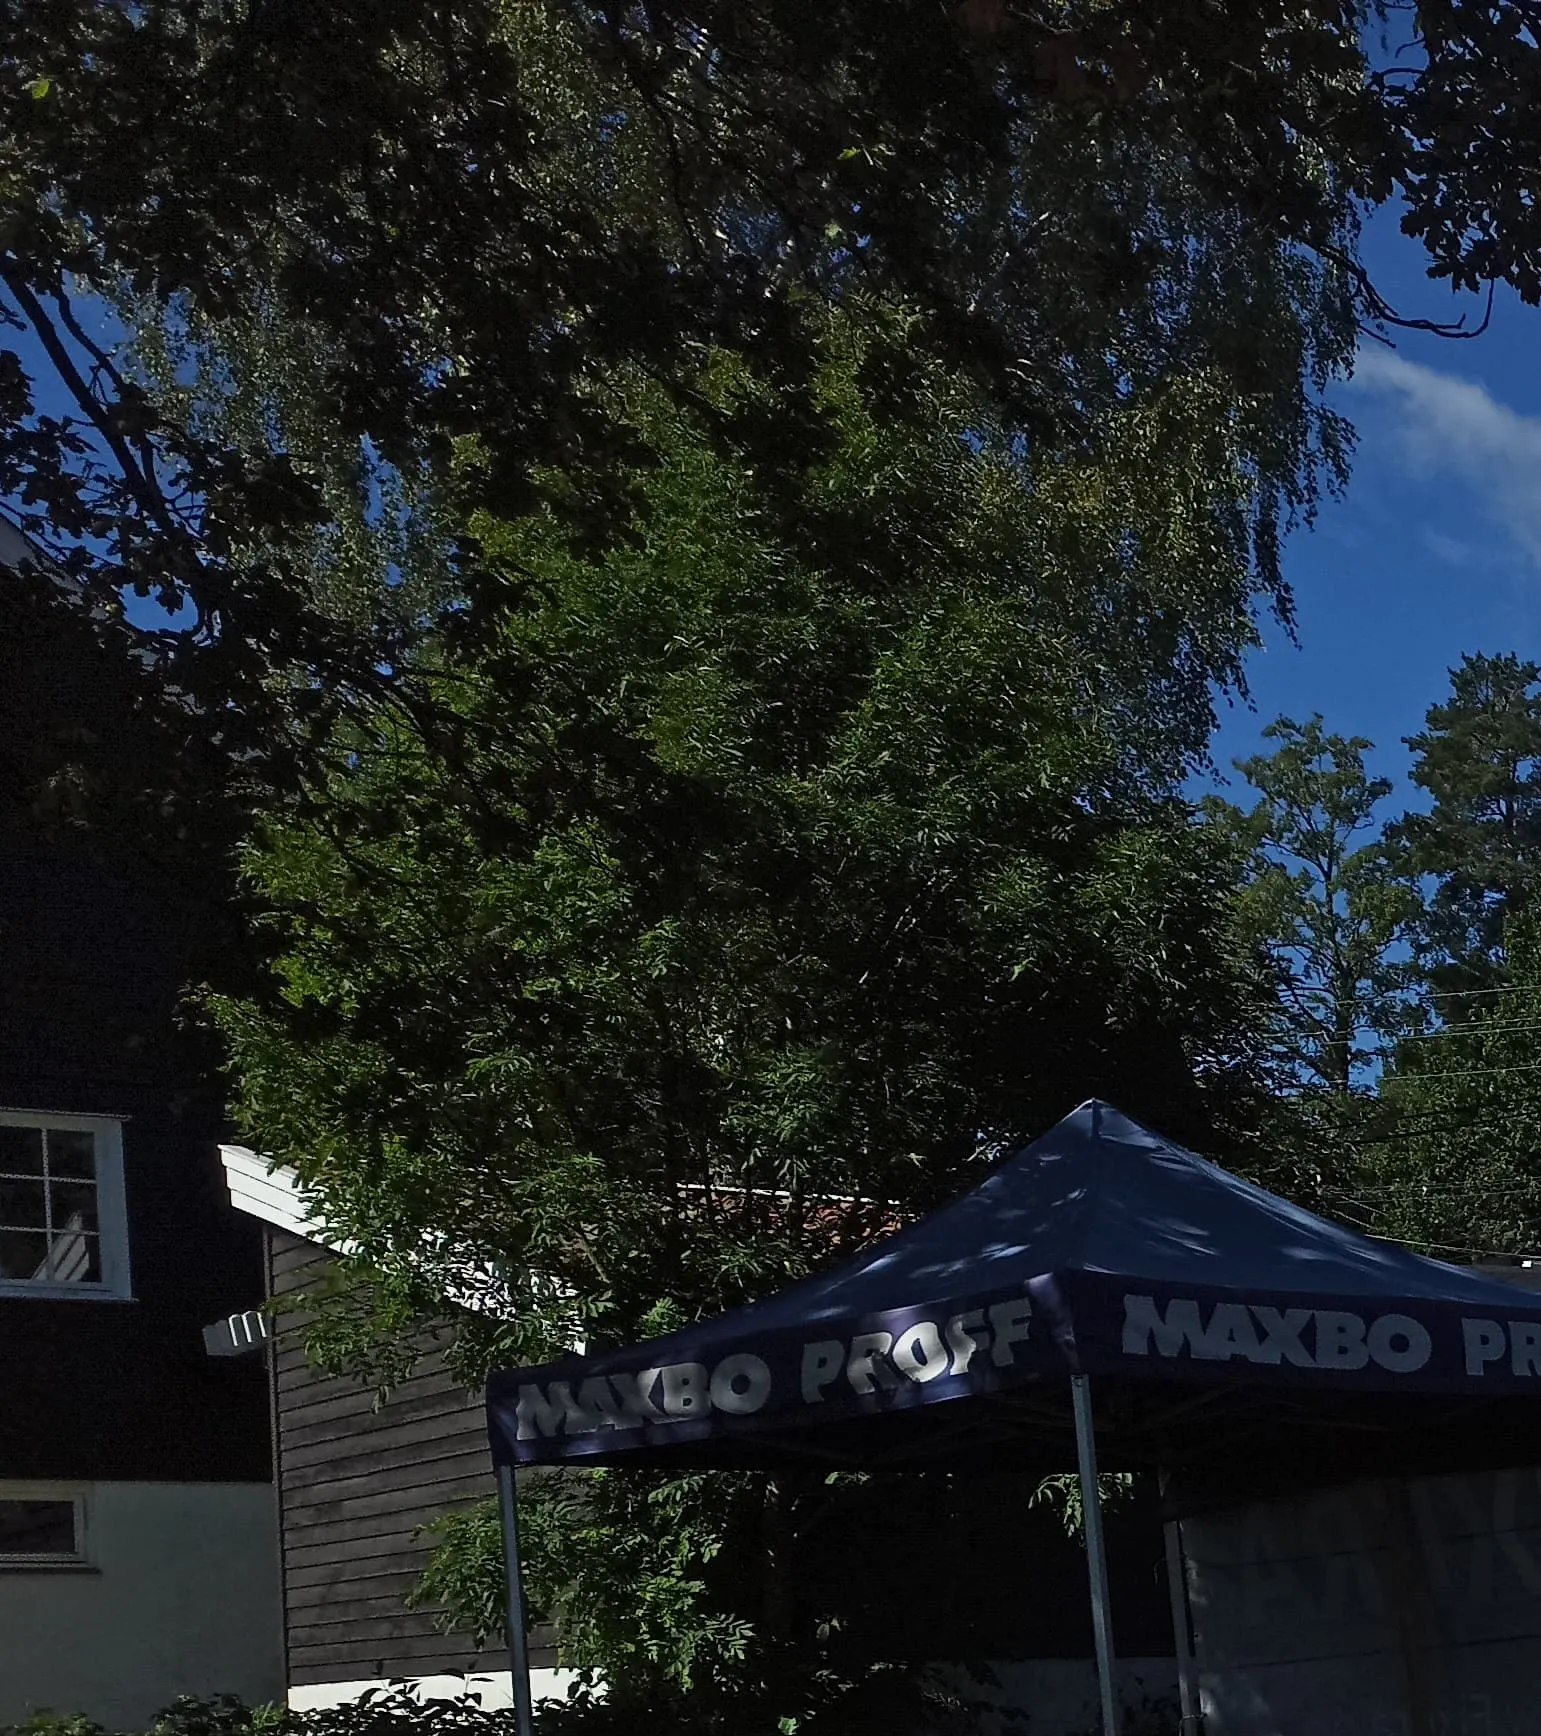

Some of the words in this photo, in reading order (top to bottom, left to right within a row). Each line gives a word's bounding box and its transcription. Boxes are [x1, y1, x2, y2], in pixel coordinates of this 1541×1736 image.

[516, 1353, 772, 1441] MAXBO
[801, 1298, 1032, 1402] PROFF
[1122, 1294, 1432, 1373] MAXBO
